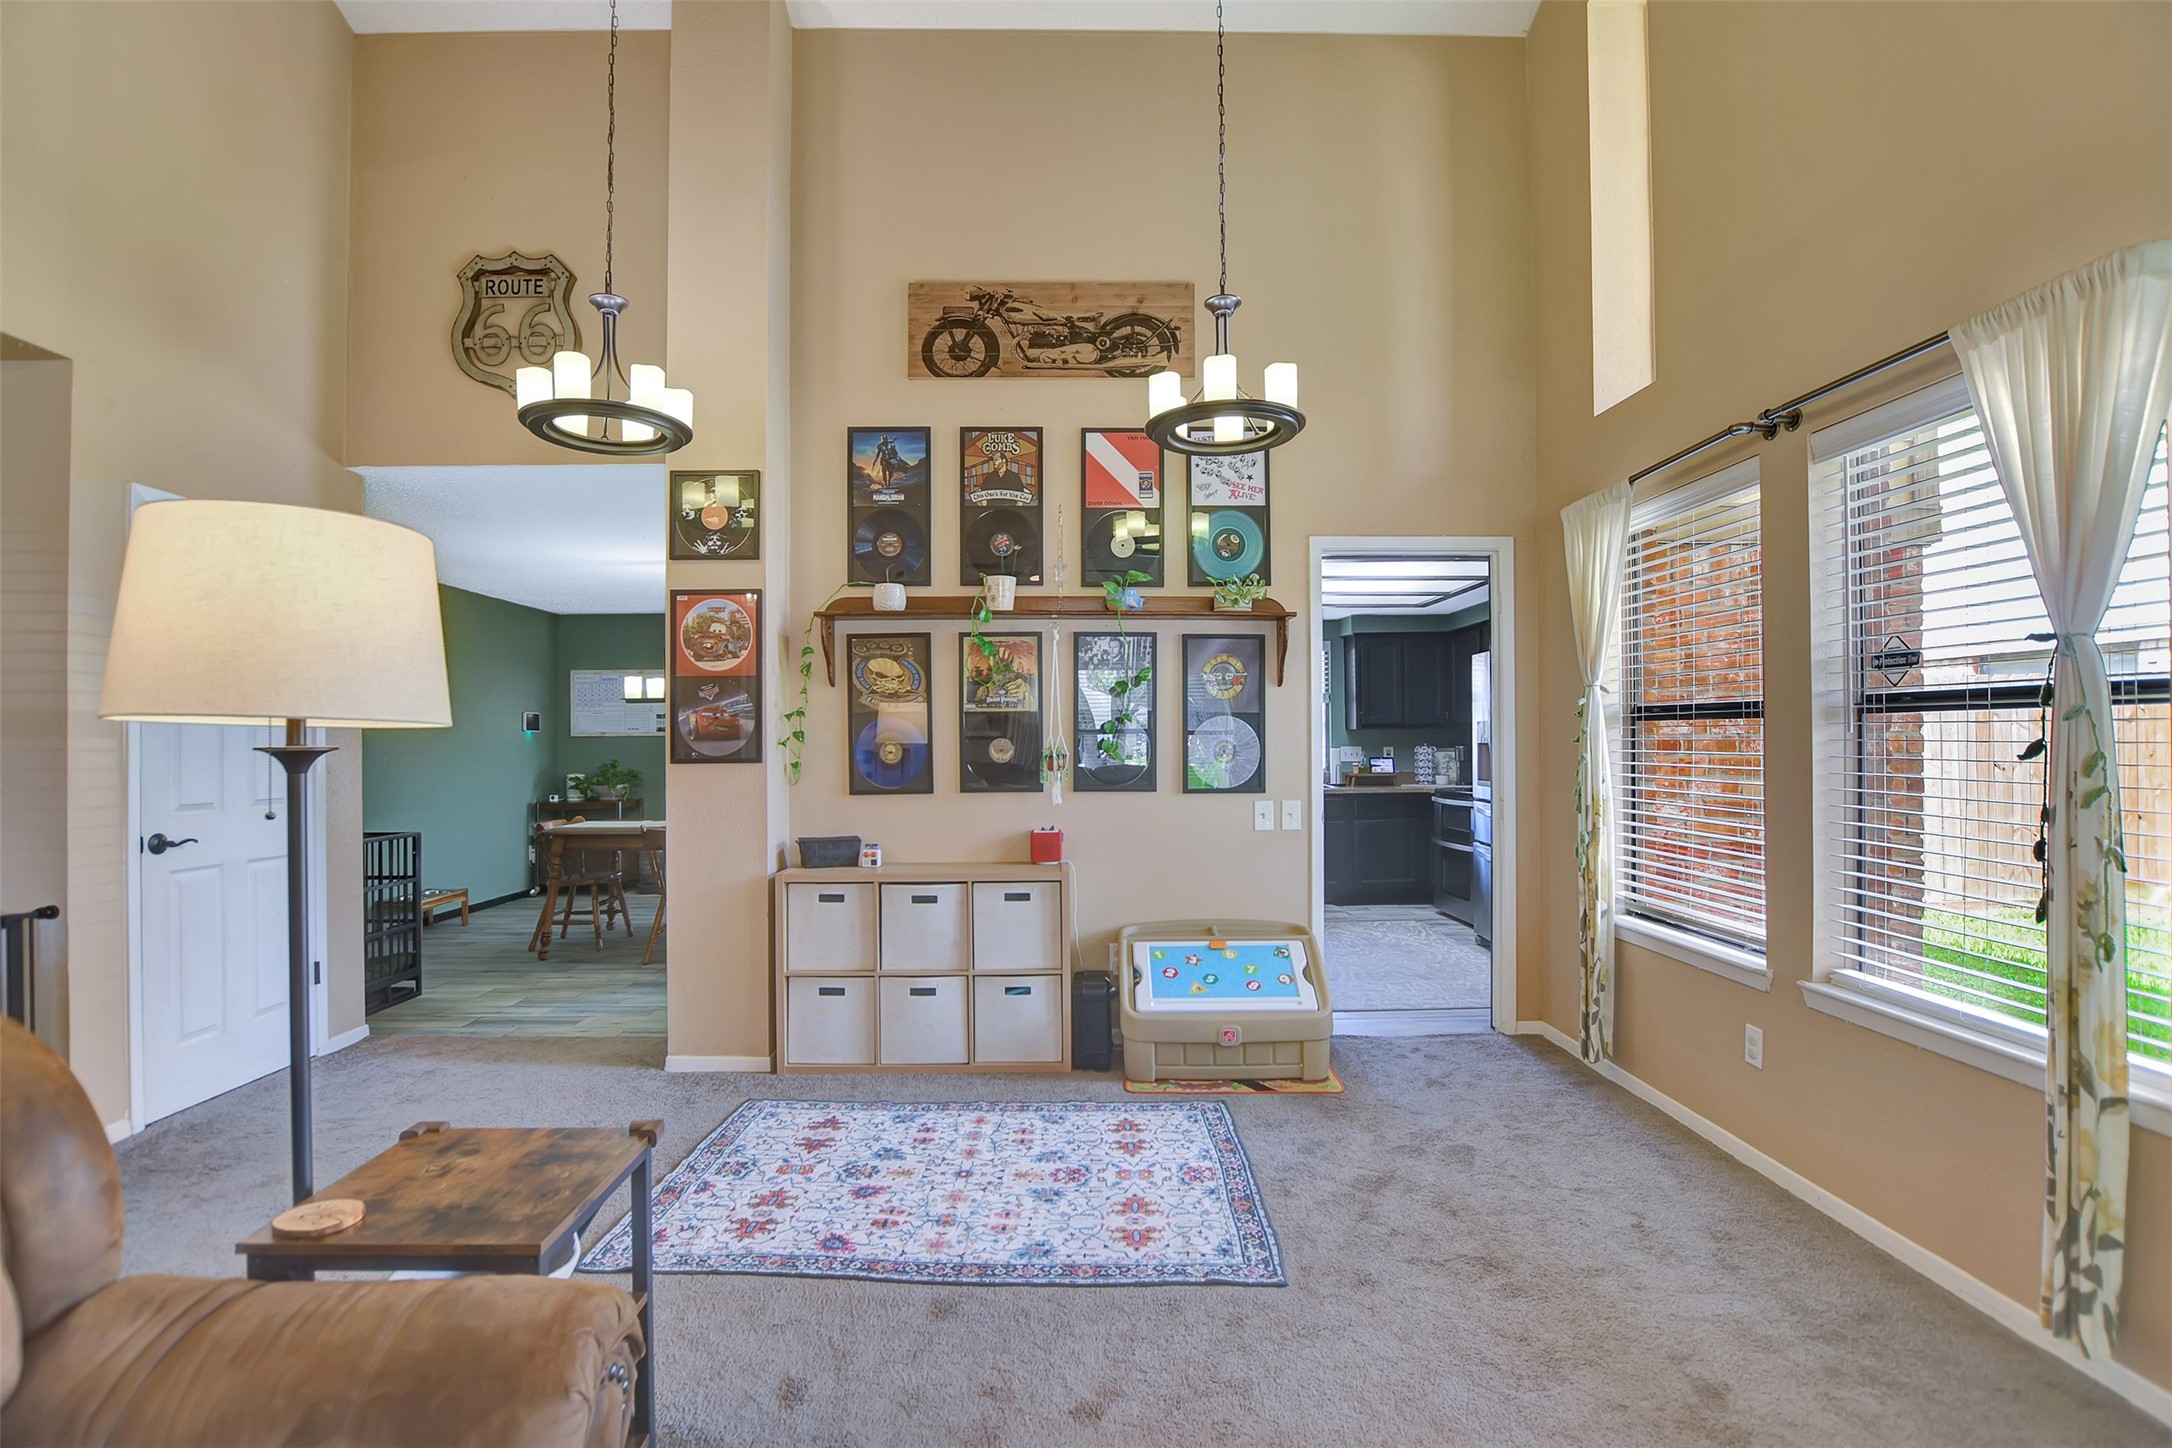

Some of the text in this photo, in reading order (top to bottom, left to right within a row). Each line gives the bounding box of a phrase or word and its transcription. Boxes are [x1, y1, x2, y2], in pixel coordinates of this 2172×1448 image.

[485, 279, 544, 295] ROUTE
[473, 303, 556, 366] 66
[987, 432, 1016, 443] LUKE
[982, 442, 1021, 455] COMBS
[1231, 481, 1264, 494] SEE HER
[1164, 968, 1177, 978] 2
[1205, 975, 1216, 984] 5
[1247, 981, 1260, 992] 8
